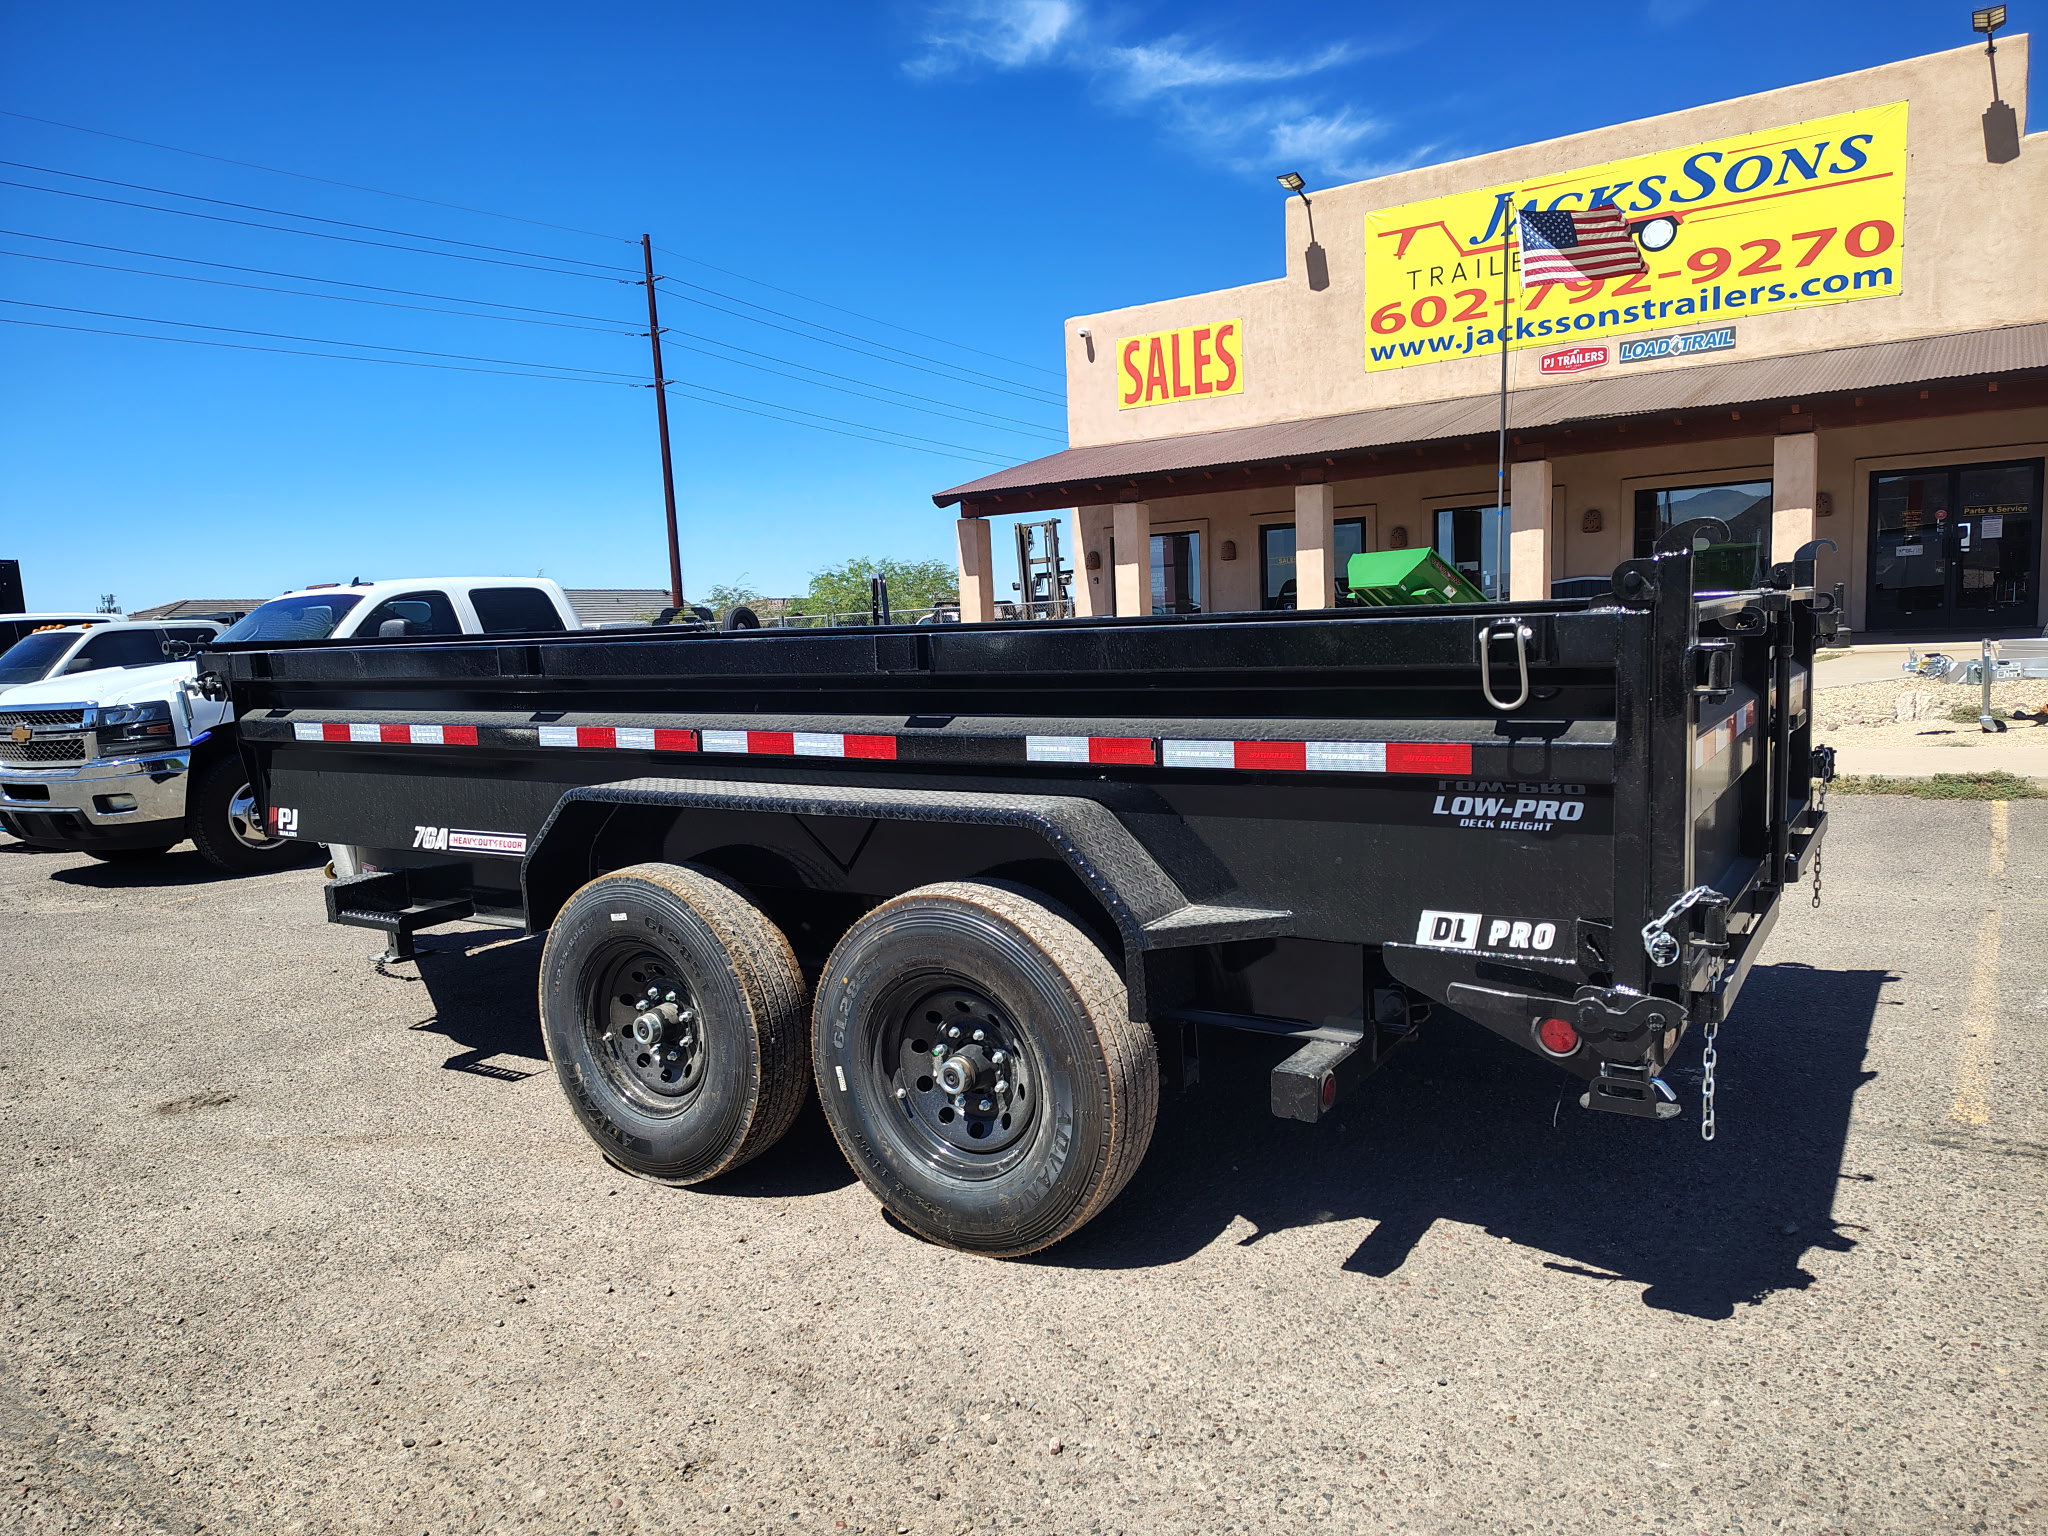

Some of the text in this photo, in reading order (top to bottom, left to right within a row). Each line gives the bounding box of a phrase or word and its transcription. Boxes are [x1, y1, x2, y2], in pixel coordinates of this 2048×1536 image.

[1407, 251, 1523, 290] TRAILE
[1370, 267, 1893, 362] www.jackssonstrailers.com
[1620, 329, 1735, 361] LOAD TRAIL
[1123, 324, 1237, 405] SALES
[1543, 357, 1555, 369] PJ
[1557, 350, 1605, 367] TRAILERS
[1963, 507, 1986, 515] Parts
[1996, 504, 2028, 513] Service
[278, 807, 299, 831] PJ
[1432, 795, 1585, 822] LOW-PRO
[412, 825, 449, 851] 7GA
[1459, 818, 1554, 832] DECK HEIGHT
[1432, 915, 1556, 950] DL PRO
